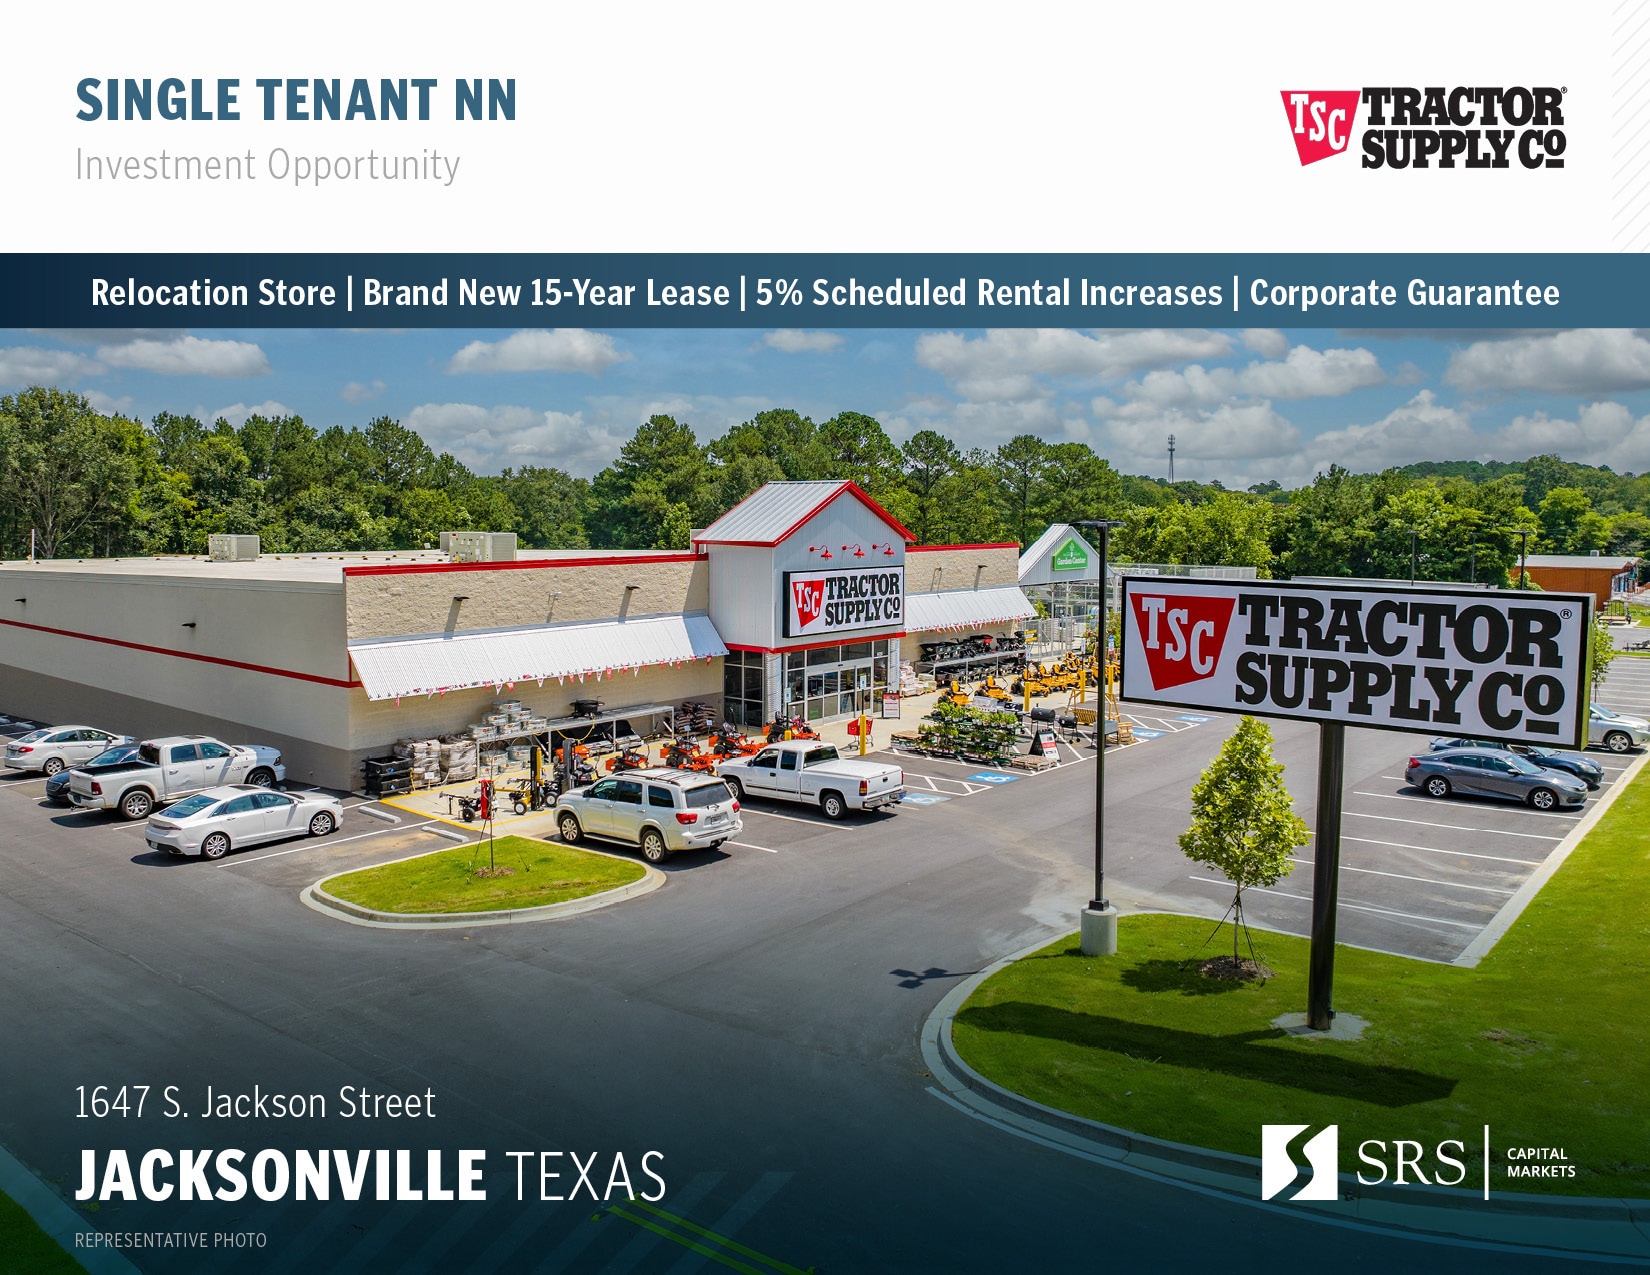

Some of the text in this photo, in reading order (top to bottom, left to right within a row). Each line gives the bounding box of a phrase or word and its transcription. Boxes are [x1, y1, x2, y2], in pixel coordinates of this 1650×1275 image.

[796, 582, 820, 617] TSC
[825, 573, 900, 600] TRACTOR
[825, 598, 883, 627] SUPPLY
[1141, 596, 1215, 676] TSC
[1235, 651, 1474, 726] SUPPLY
